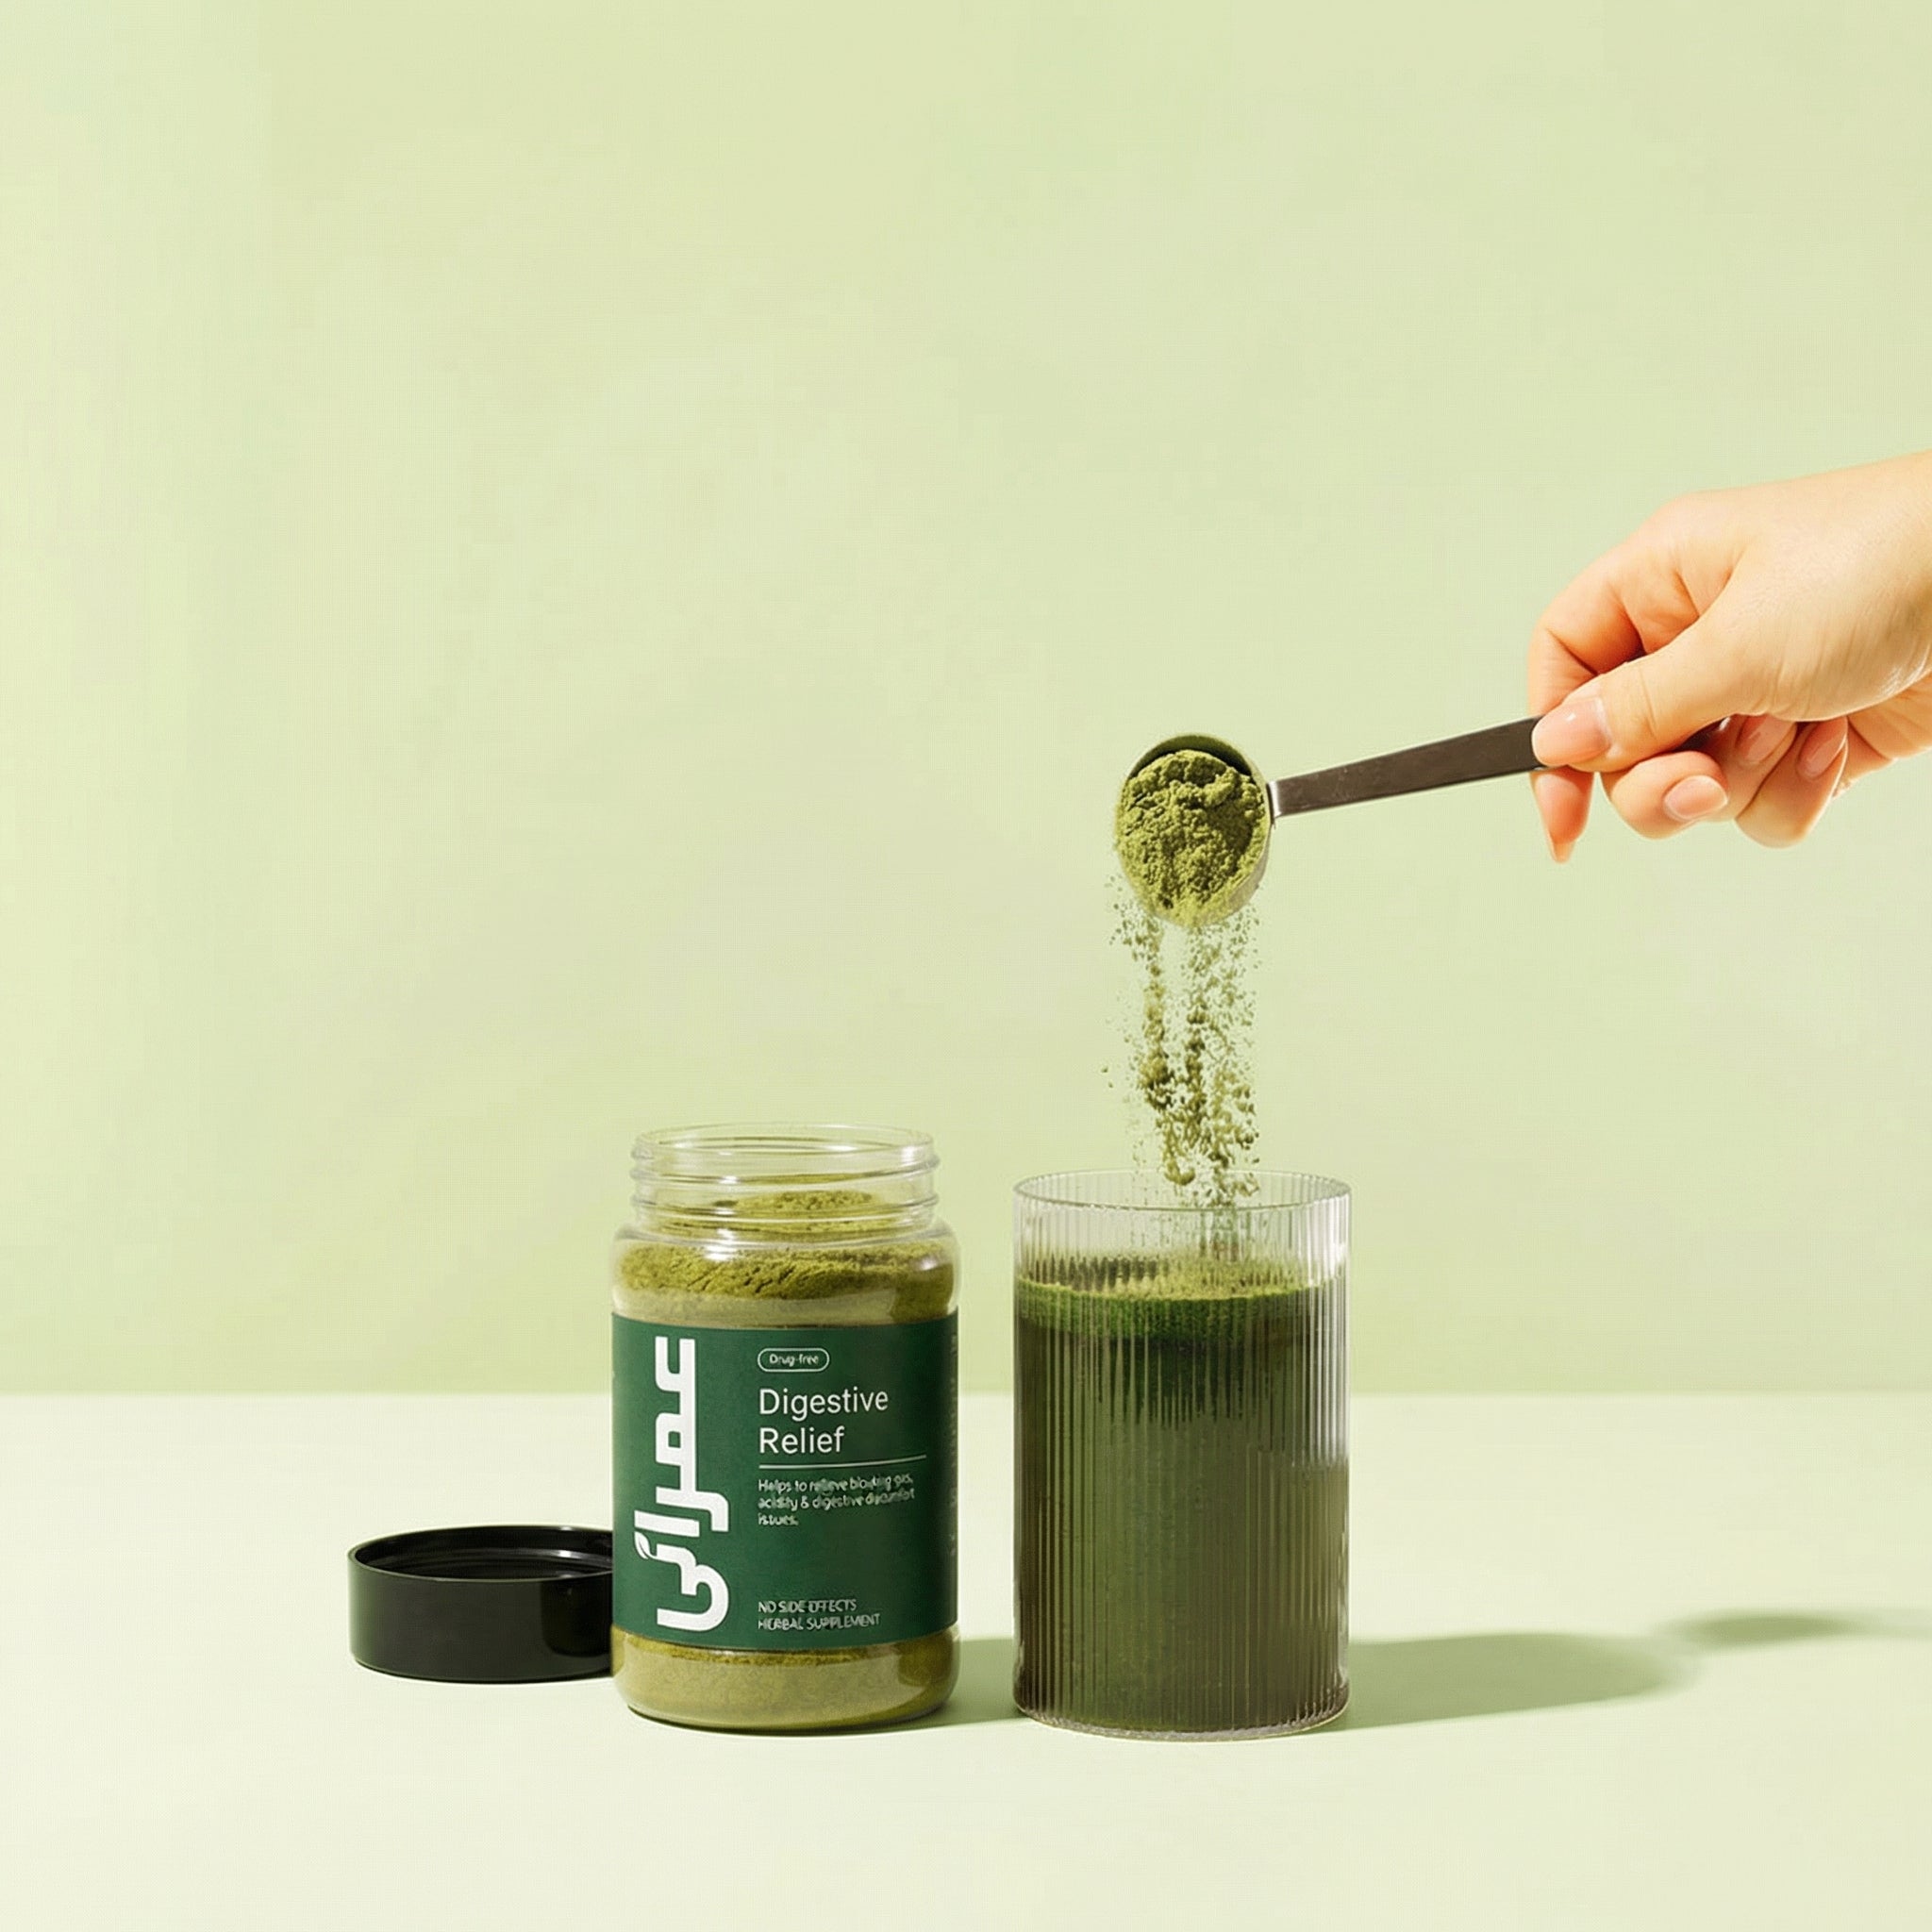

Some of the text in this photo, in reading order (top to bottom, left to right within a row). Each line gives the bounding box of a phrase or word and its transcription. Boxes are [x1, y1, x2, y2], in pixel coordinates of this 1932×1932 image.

[758, 1386, 889, 1423] Digestive
[758, 1425, 845, 1454] Relief
[794, 1478, 808, 1492] to
[800, 1496, 809, 1509] &
